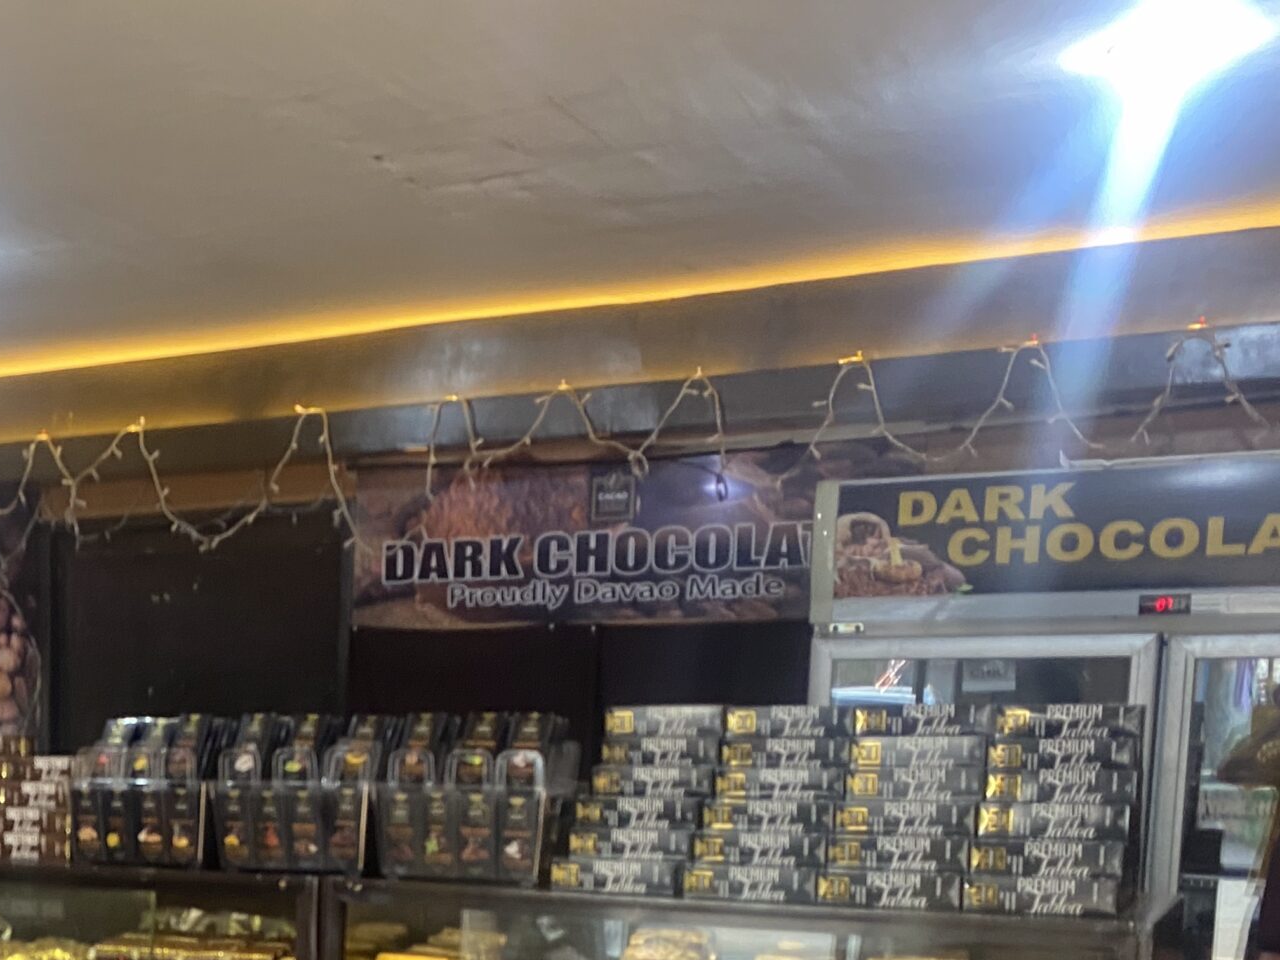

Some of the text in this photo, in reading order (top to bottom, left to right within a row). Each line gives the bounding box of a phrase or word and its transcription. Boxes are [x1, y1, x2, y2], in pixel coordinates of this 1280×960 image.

[897, 482, 1077, 526] DARK
[947, 513, 1280, 567] CHOCOLA
[382, 534, 524, 584] DARK
[447, 573, 785, 610] Proudly Davao Made
[1047, 704, 1102, 719] PREMIUM
[1039, 739, 1095, 753] PREMIUM
[1039, 769, 1096, 784] PREMIUM
[1032, 804, 1088, 818] PREMIUM
[1024, 842, 1082, 857] PREMIUM
[1017, 878, 1076, 894] PREMIUM
